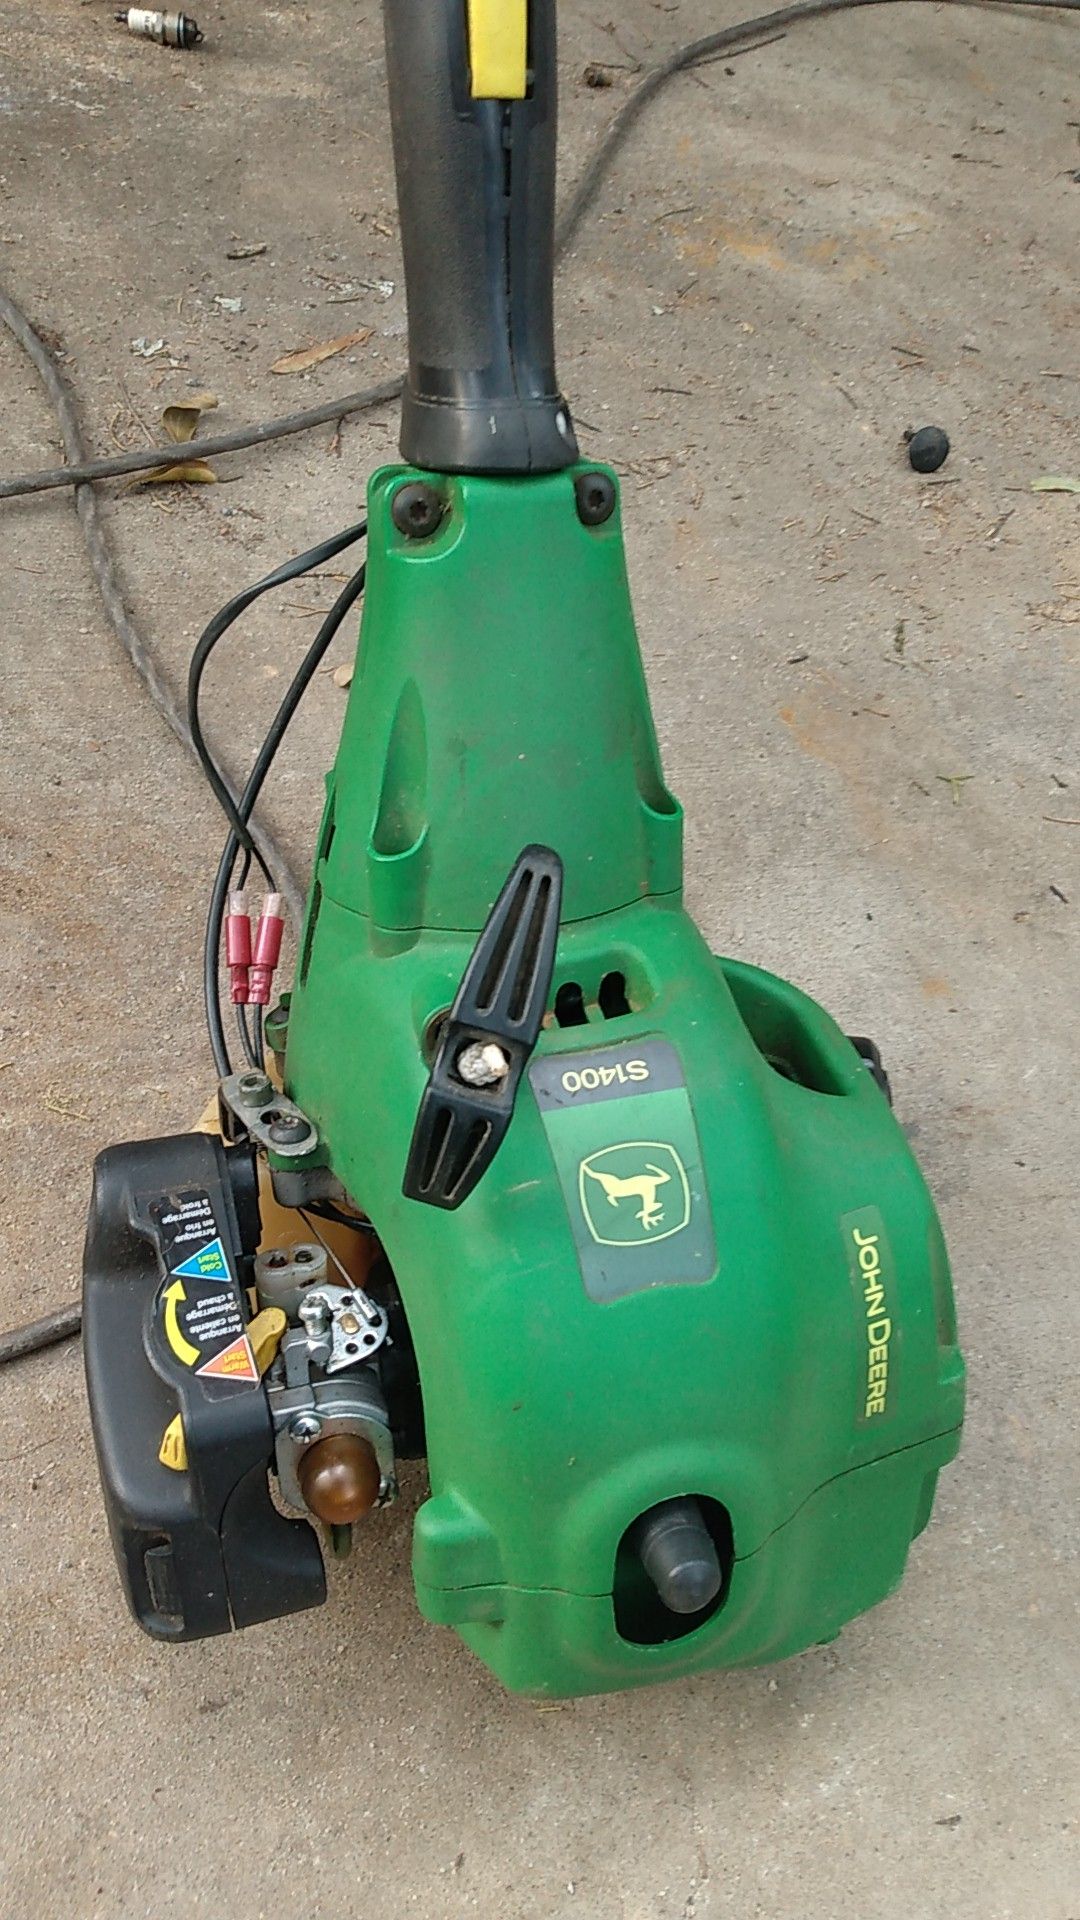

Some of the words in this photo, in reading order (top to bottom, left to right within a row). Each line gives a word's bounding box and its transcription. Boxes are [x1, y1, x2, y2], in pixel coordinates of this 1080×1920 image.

[561, 1060, 649, 1093] S1400
[202, 1218, 214, 1227] en
[174, 1226, 216, 1243] Arranque
[197, 1252, 220, 1265] Start
[200, 1261, 222, 1274] Cold
[852, 1228, 885, 1317] JOHN
[197, 1295, 226, 1309] chaud
[189, 1317, 226, 1334] caliente
[228, 1314, 240, 1322] en
[198, 1323, 242, 1342] Arranque
[865, 1318, 891, 1418] DEERE
